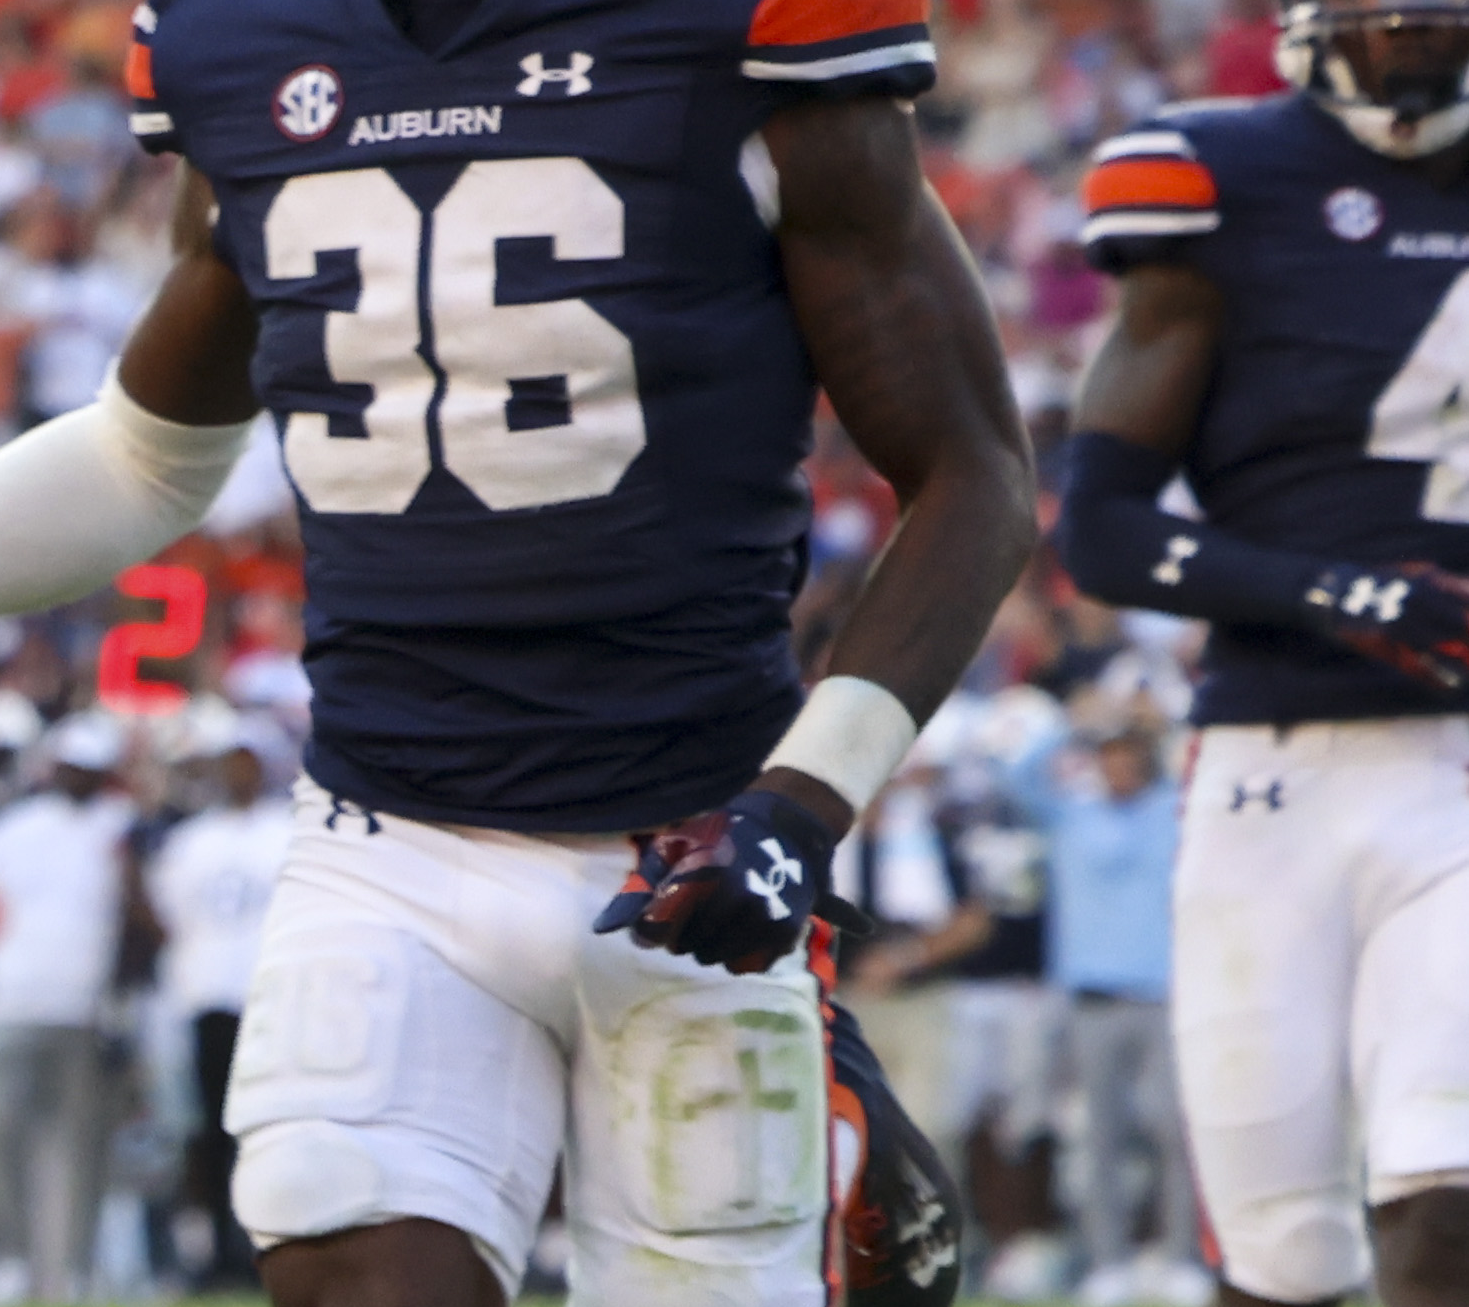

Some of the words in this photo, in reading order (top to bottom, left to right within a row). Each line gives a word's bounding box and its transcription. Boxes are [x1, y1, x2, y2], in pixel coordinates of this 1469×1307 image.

[347, 105, 503, 147] AUBURN
[263, 156, 647, 514] 36
[94, 561, 208, 716] 2
